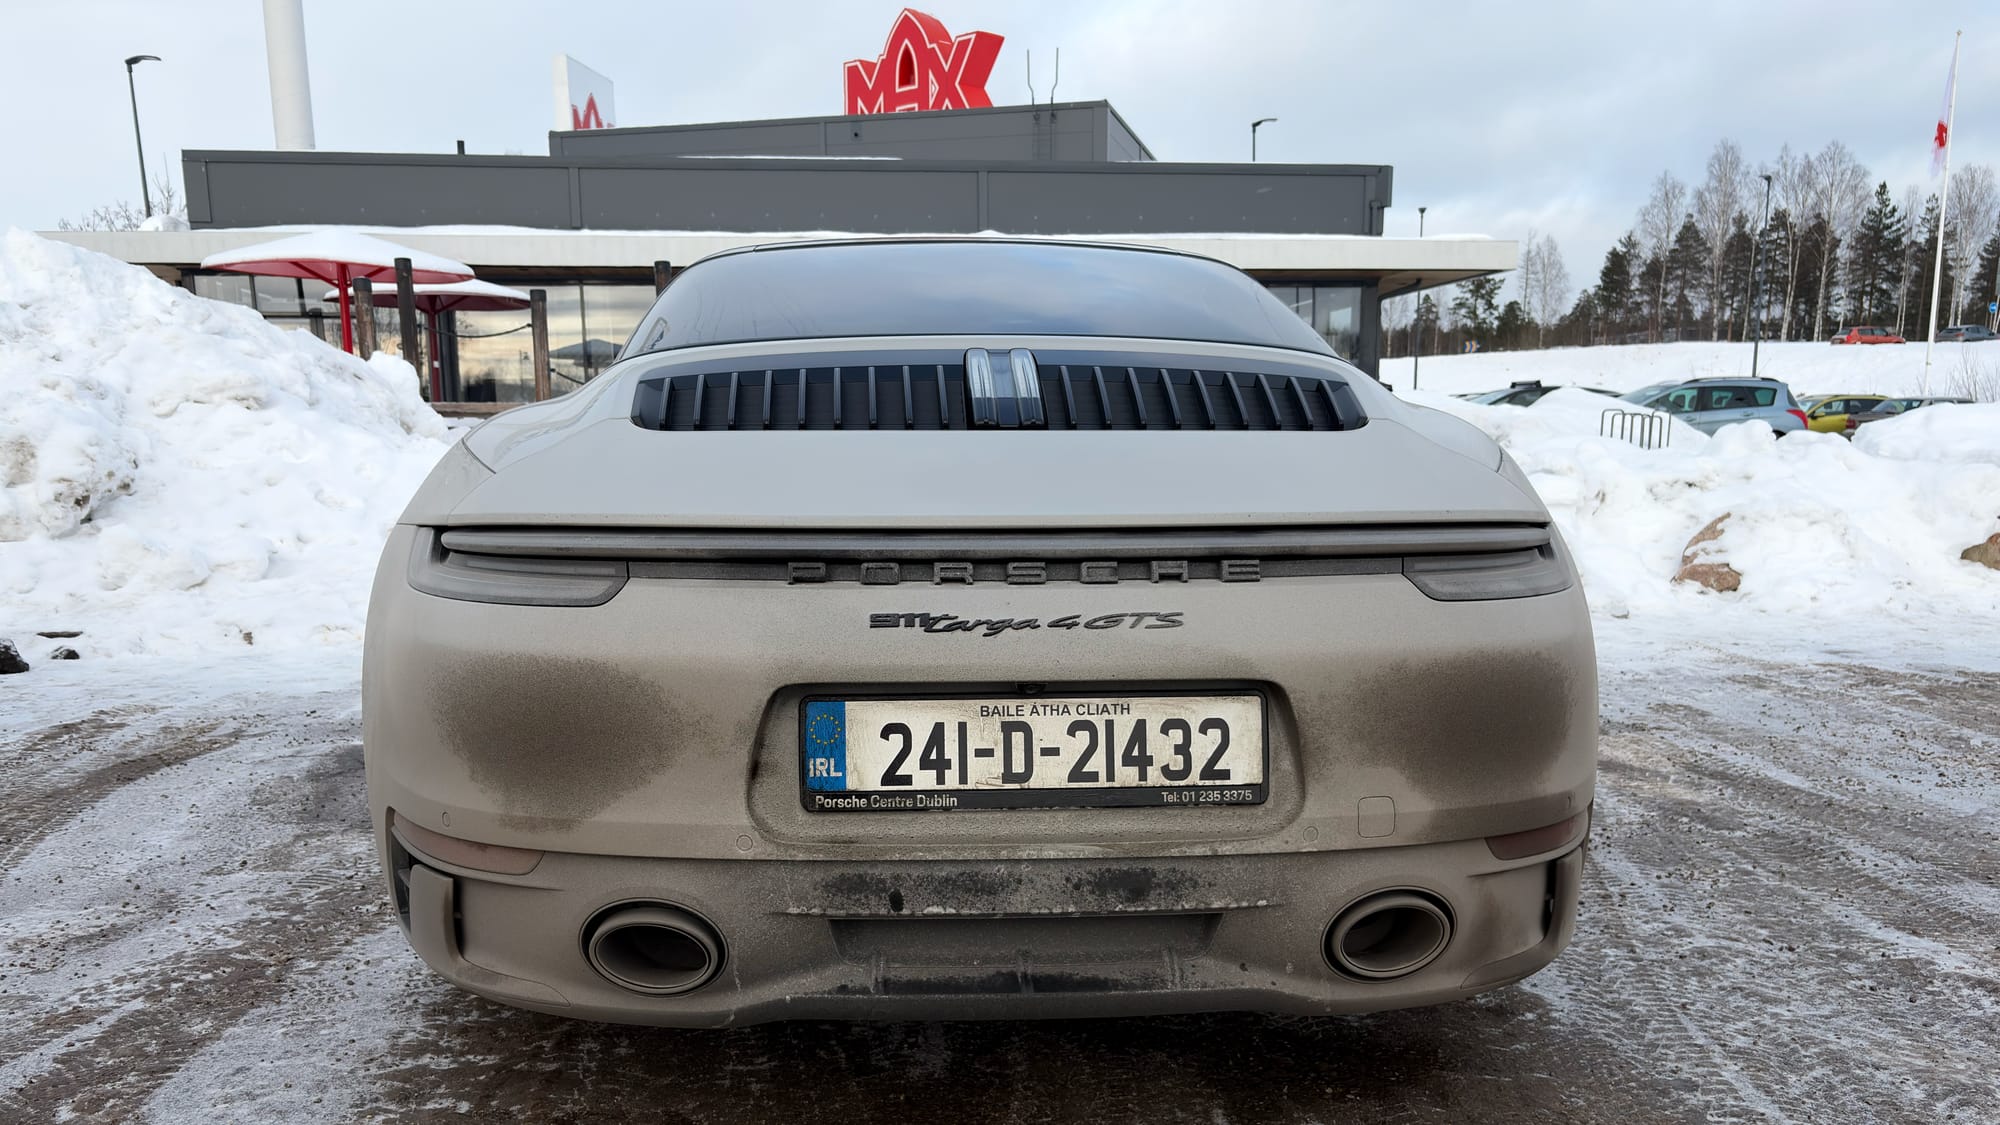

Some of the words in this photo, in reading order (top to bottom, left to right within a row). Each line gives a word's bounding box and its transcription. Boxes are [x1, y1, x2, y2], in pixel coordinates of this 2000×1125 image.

[843, 8, 1004, 115] MAX
[571, 92, 615, 130] MA
[787, 560, 1261, 585] PORSCHE
[869, 612, 931, 628] 911
[1047, 614, 1081, 630] 4
[1083, 612, 1184, 630] GTS
[980, 704, 1025, 717] BAILE
[1029, 702, 1072, 717] ÁTHA
[1075, 703, 1130, 716] CLIATH
[808, 757, 843, 778] IRL
[815, 795, 867, 808] Porsche
[870, 795, 913, 808] Centre
[916, 794, 957, 807] Dublin
[1161, 791, 1180, 802] Tel:
[1182, 791, 1195, 802] 01
[1199, 790, 1221, 802] 235
[1223, 789, 1252, 801] 3375
